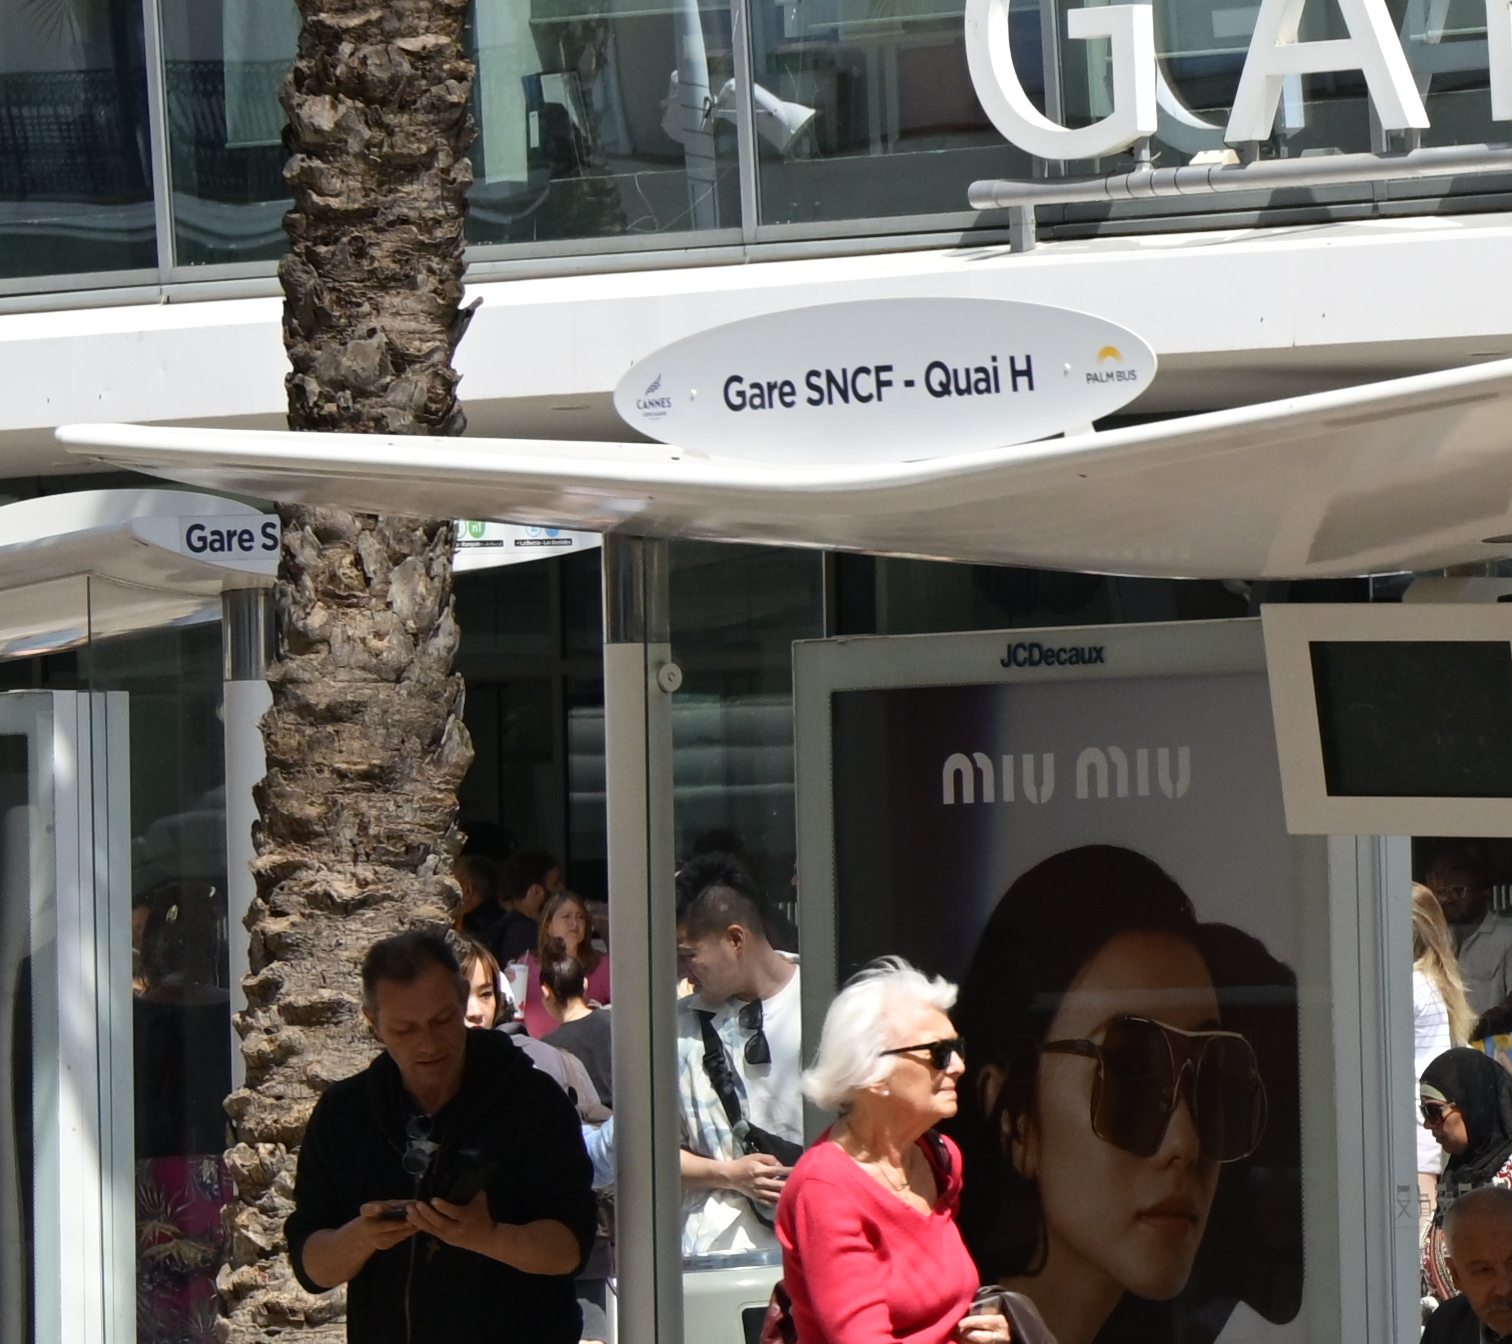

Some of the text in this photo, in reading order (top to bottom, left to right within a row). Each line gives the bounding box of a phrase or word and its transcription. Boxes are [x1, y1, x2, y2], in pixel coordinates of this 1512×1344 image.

[723, 355, 1035, 412] Gare SNCF Quai H
[1086, 369, 1137, 384] PALM BUS
[636, 397, 672, 410] CANNES
[186, 522, 257, 554] Gare
[1000, 643, 1105, 669] JCDecaux
